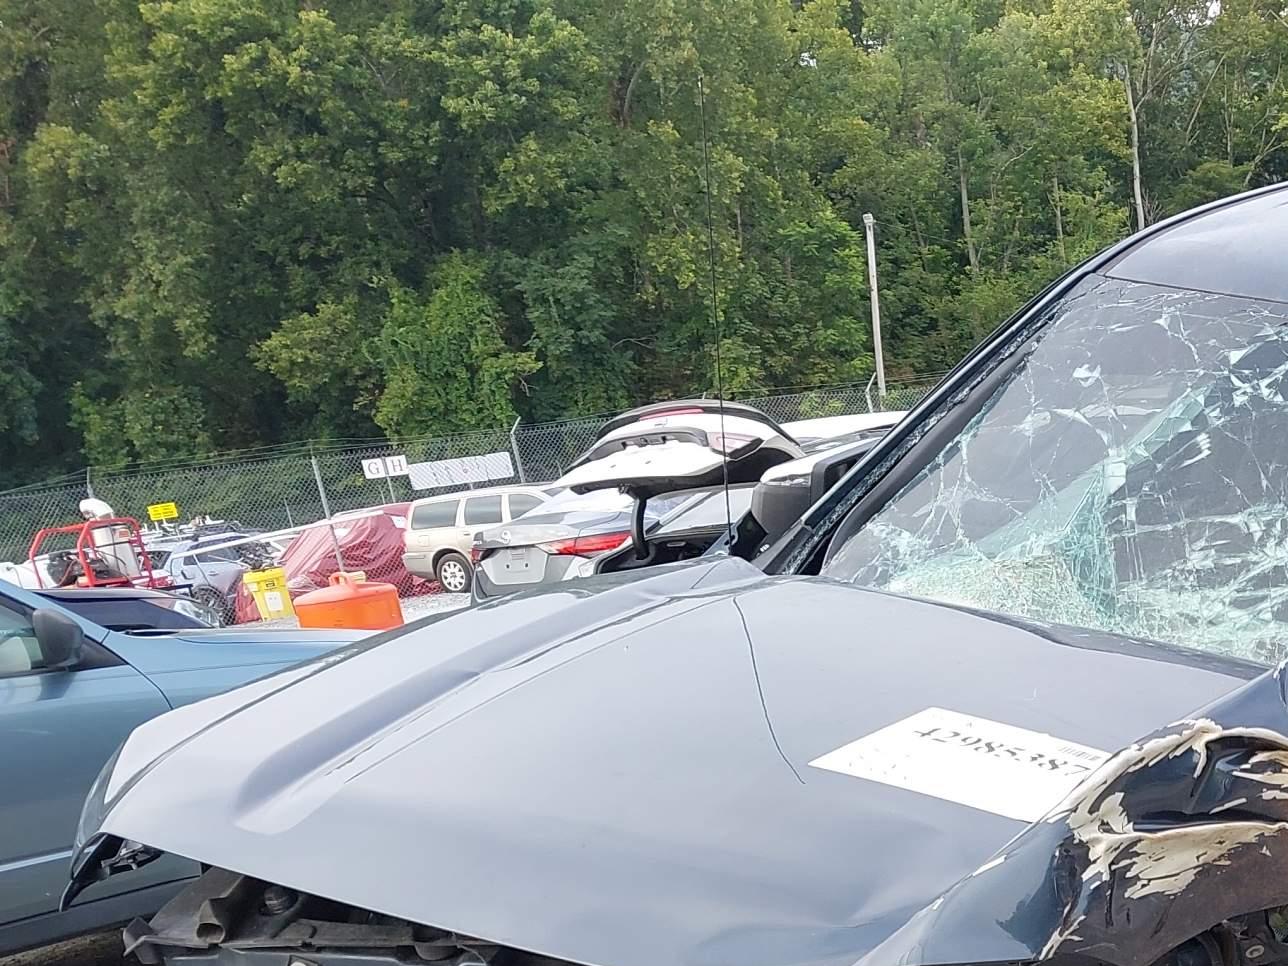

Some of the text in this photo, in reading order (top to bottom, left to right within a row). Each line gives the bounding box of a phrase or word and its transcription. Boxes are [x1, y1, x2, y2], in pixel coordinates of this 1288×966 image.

[368, 459, 404, 475] G H
[914, 727, 1091, 776] 42985387
